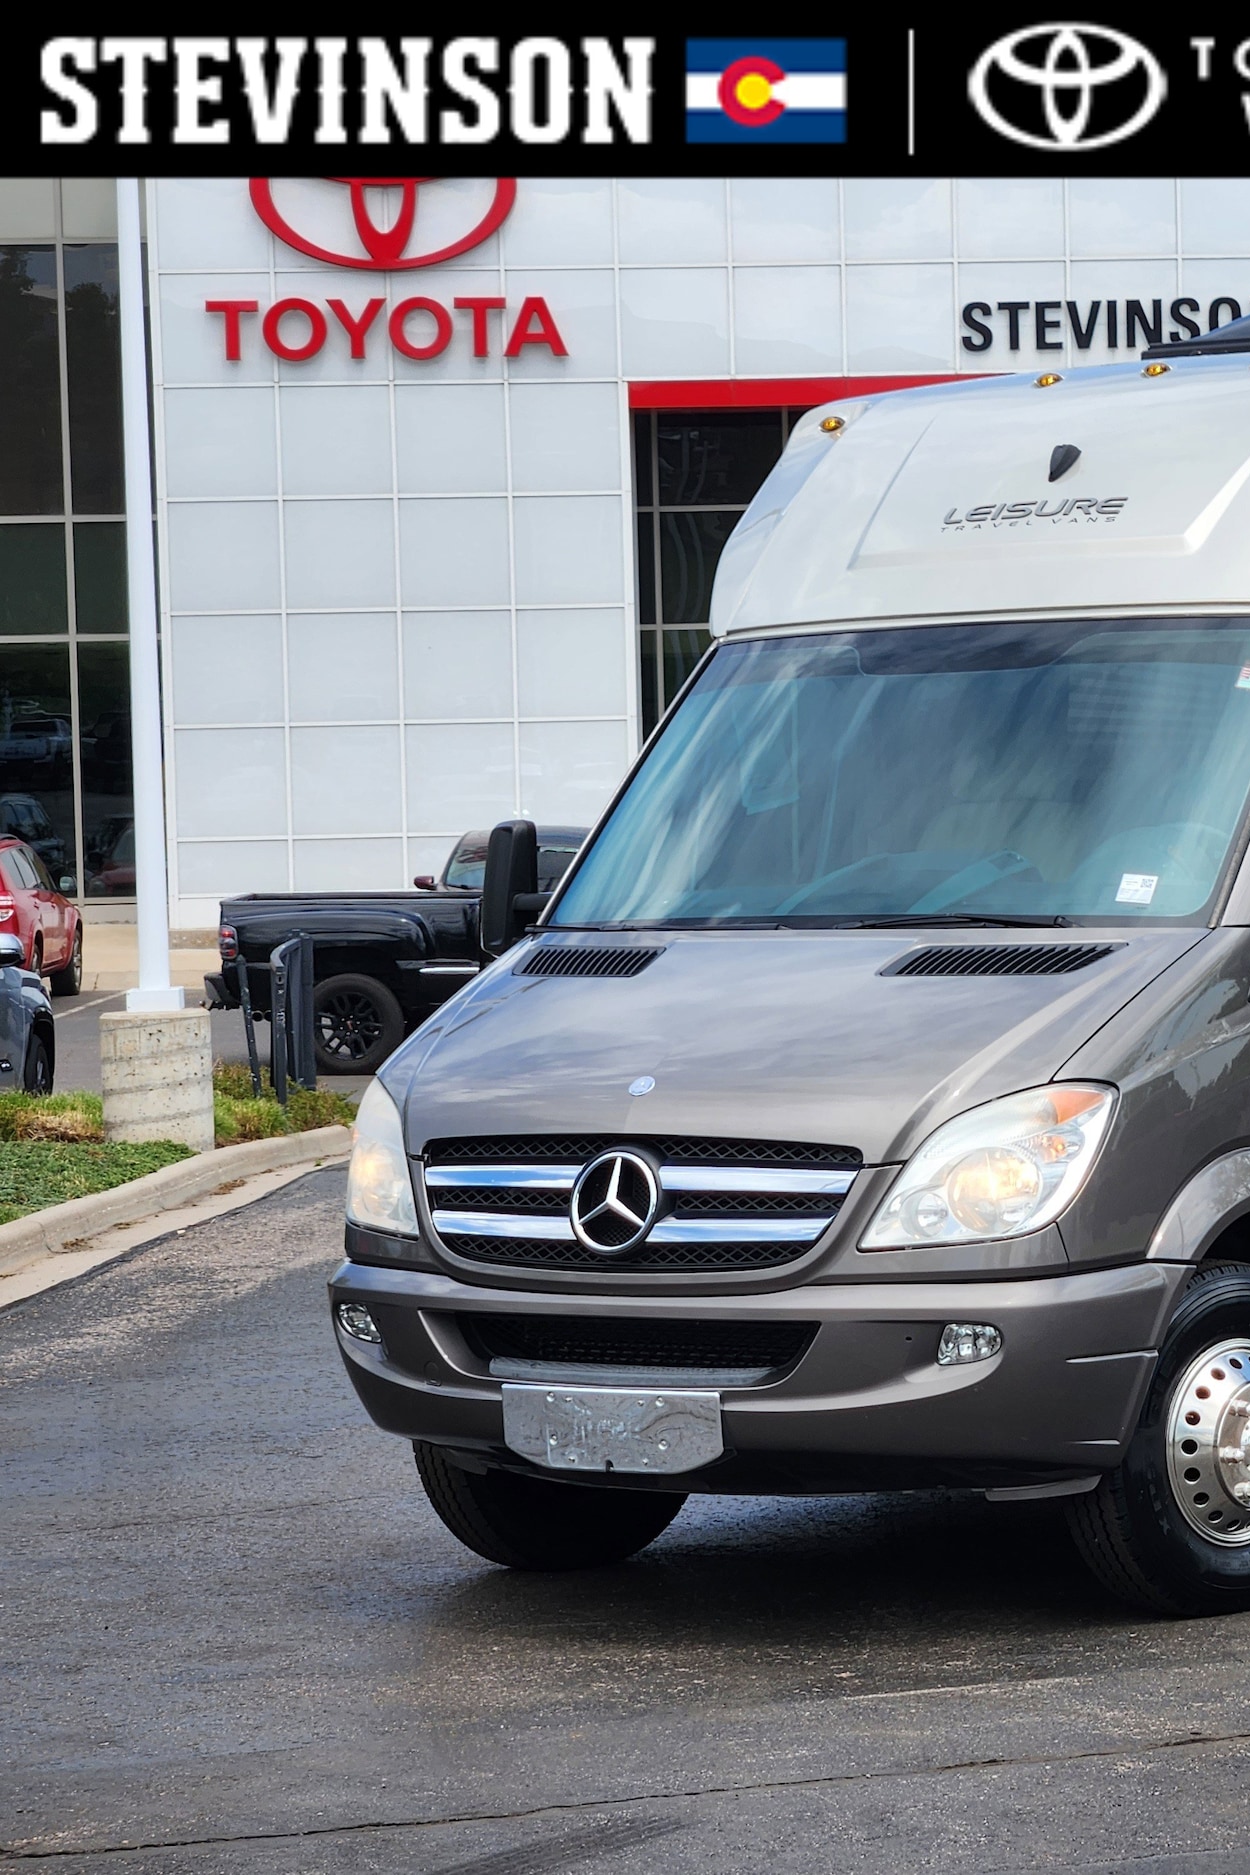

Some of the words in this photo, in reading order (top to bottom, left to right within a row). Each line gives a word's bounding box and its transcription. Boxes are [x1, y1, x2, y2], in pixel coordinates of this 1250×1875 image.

[207, 297, 566, 360] TOYOTA
[940, 520, 1033, 533] TRAVEL
[1051, 516, 1117, 525] VANS
[943, 496, 1129, 525] LEISURE
